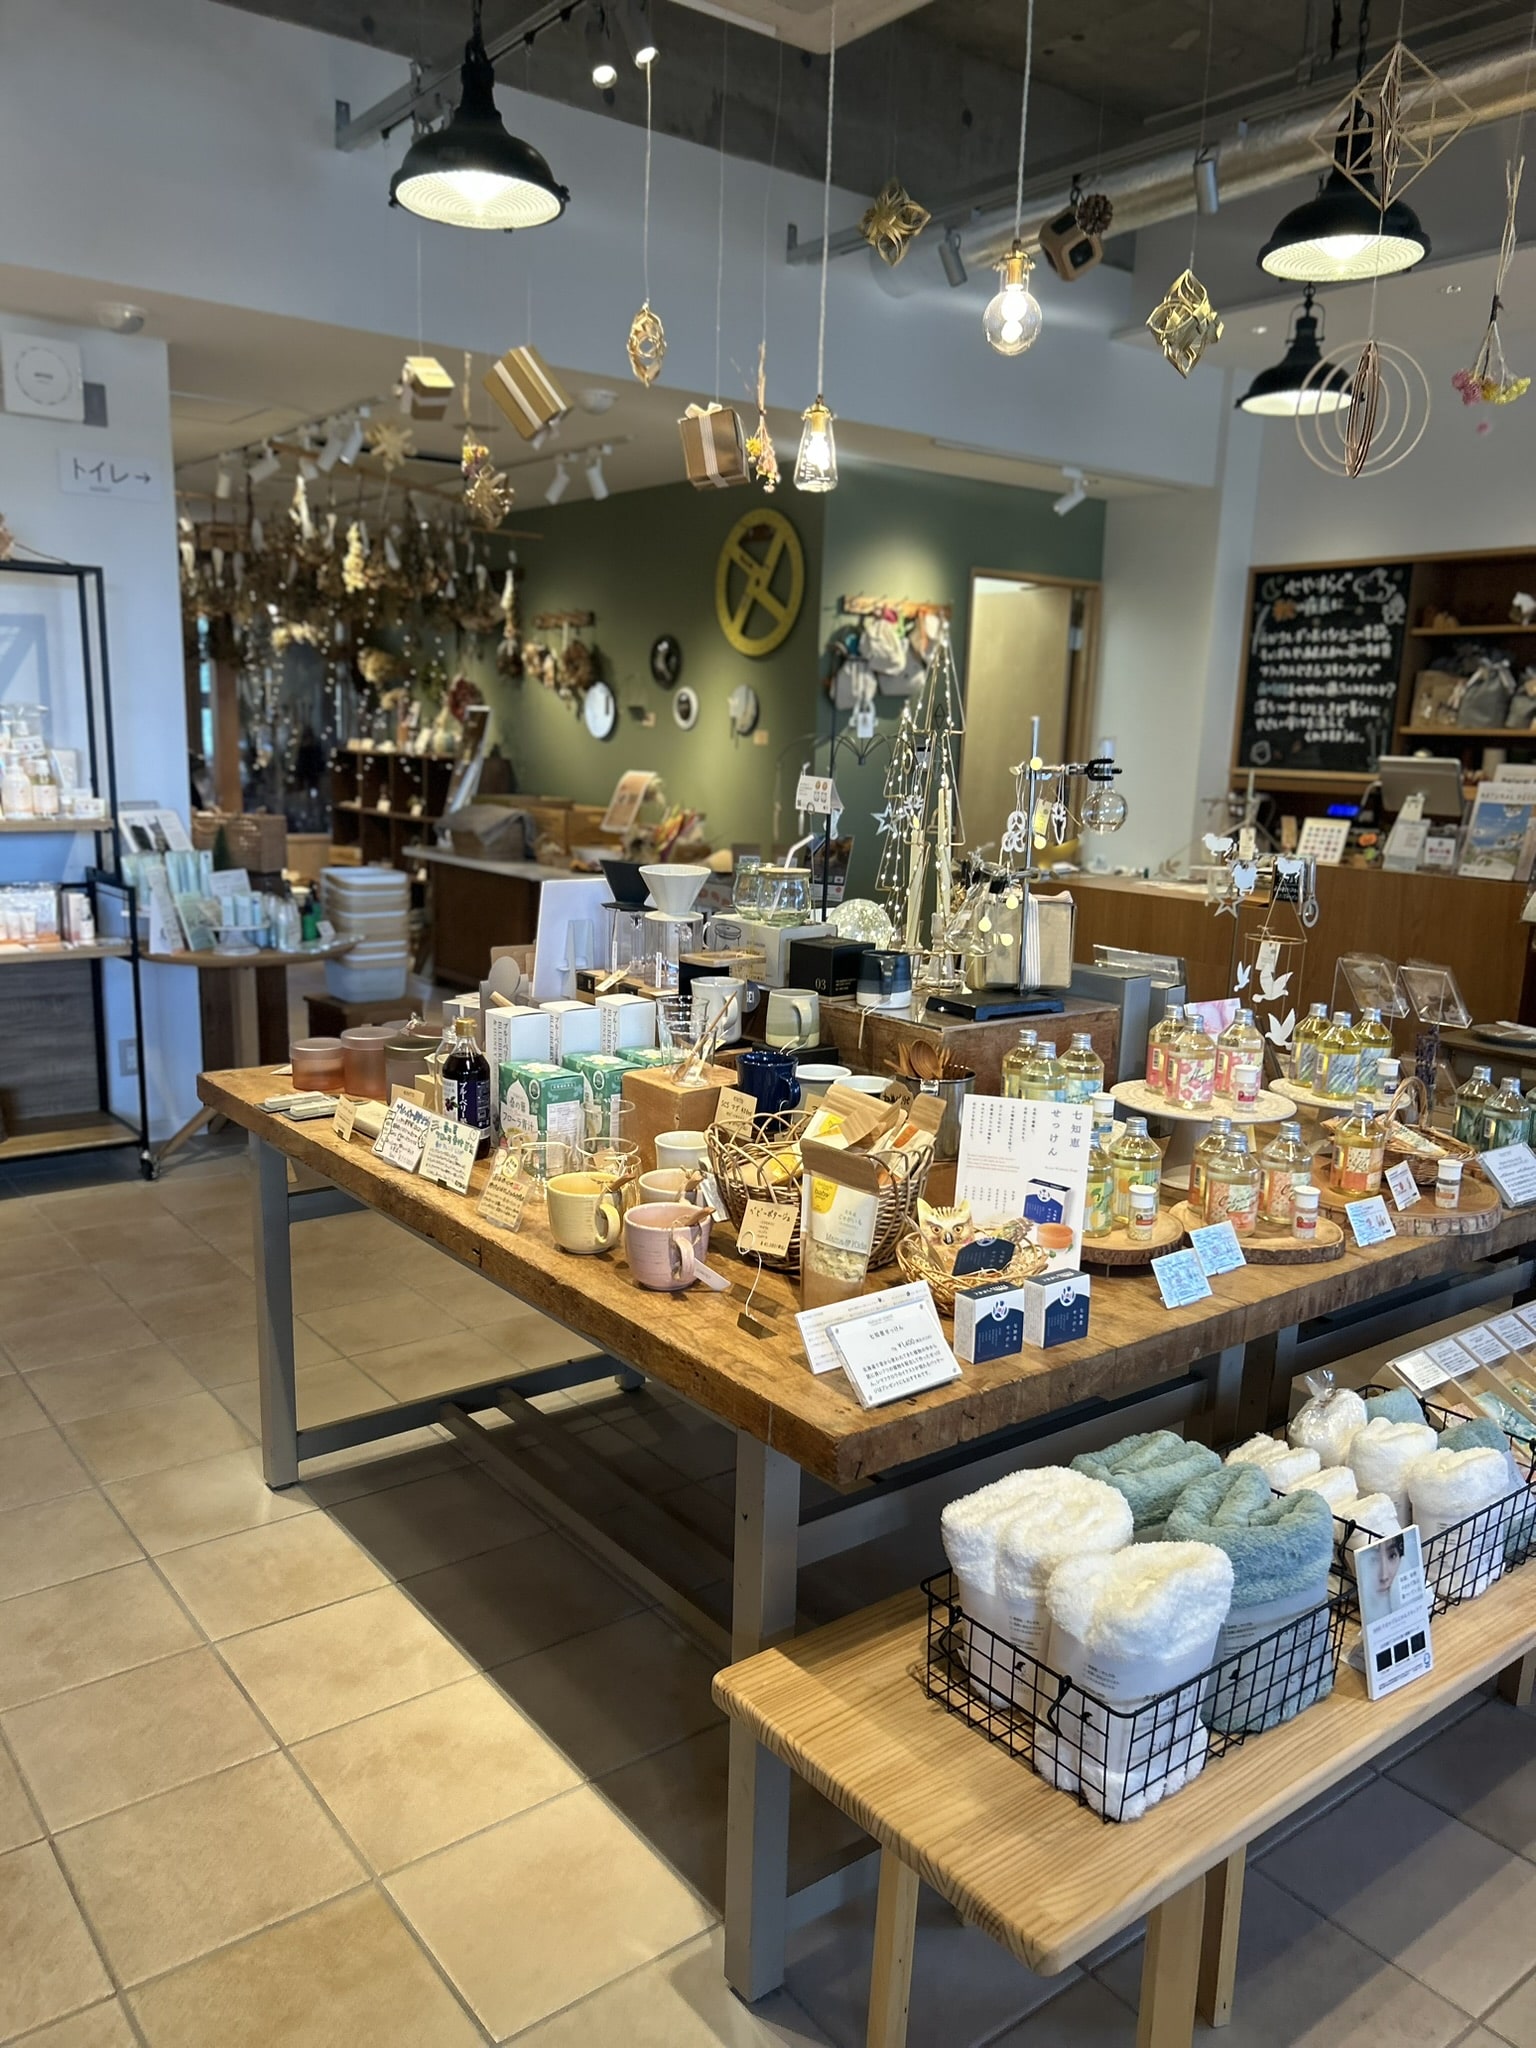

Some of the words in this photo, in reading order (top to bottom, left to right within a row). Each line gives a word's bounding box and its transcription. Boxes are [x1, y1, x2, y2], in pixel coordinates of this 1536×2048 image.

[73, 457, 129, 483] トイレ
[815, 977, 826, 990] 03
[502, 1111, 535, 1130] フローラ青汁
[1069, 1110, 1083, 1148] 七知恵
[1048, 1109, 1062, 1157] せっけん
[750, 1206, 791, 1222] ベビーポタージュ
